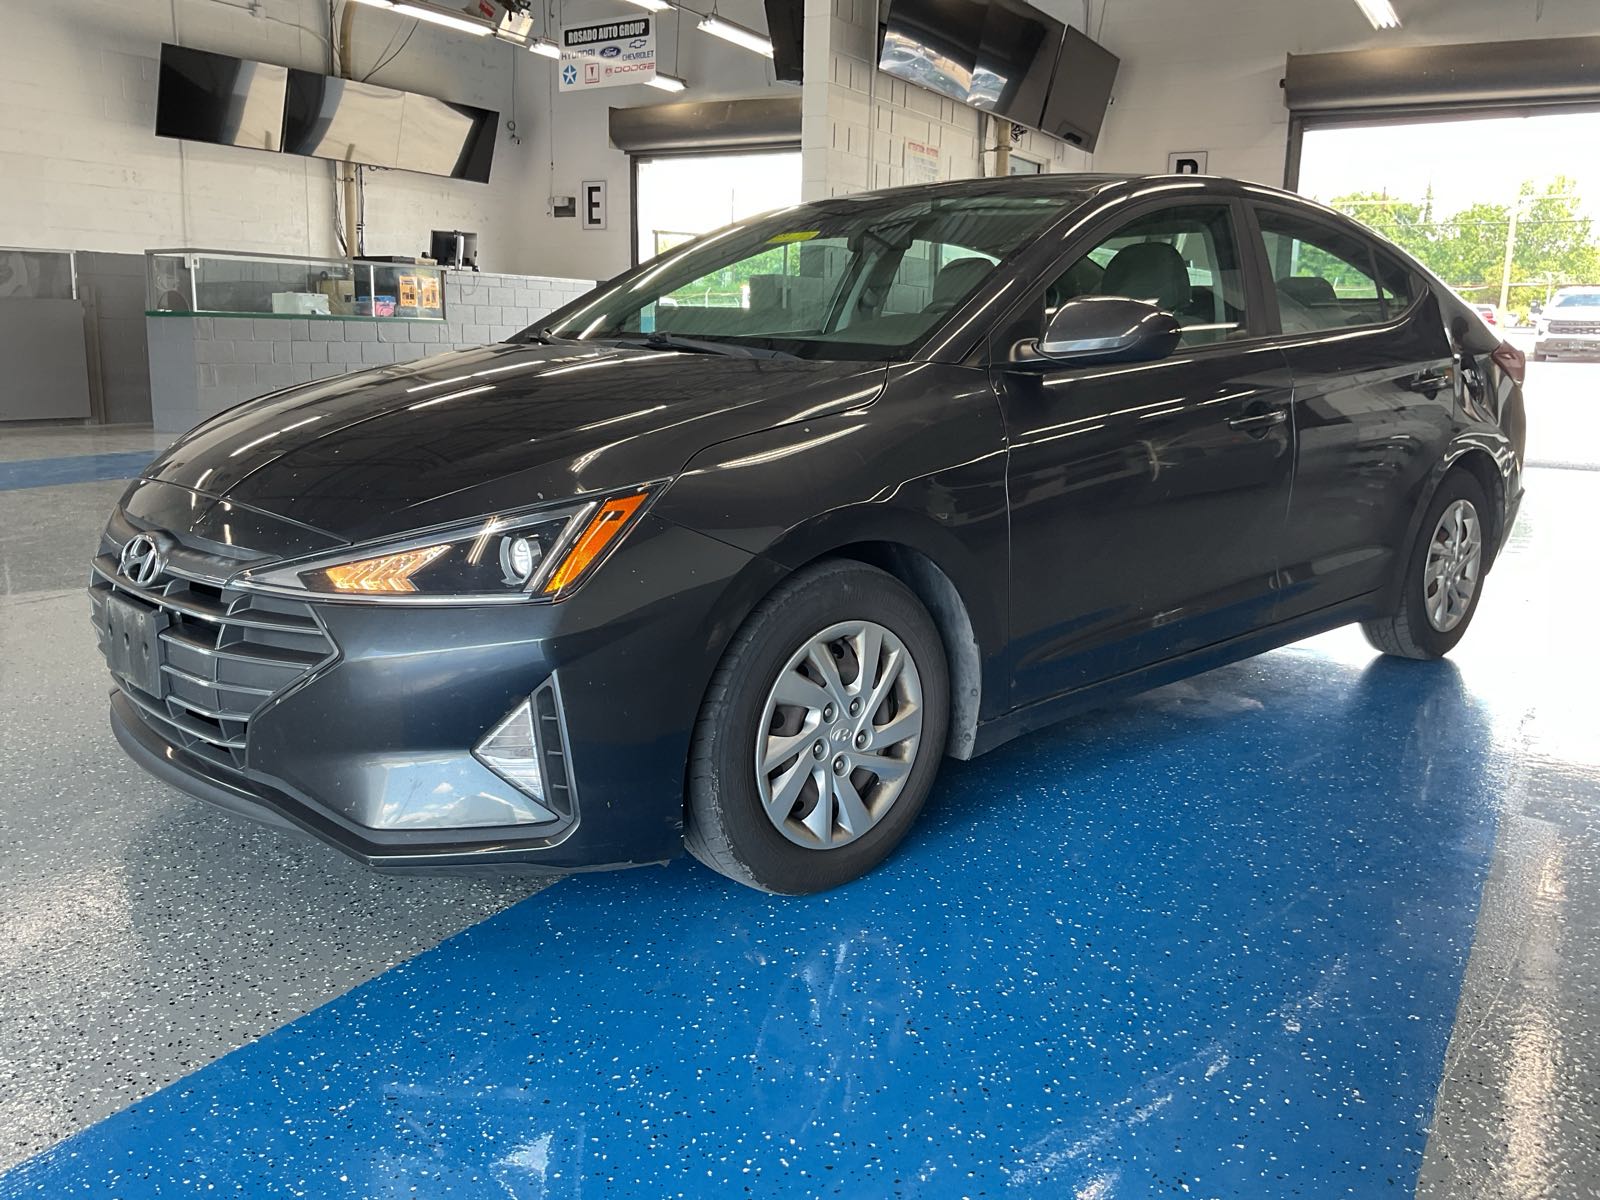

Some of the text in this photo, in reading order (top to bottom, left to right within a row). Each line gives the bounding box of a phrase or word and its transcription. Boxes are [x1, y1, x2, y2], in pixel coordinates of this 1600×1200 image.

[568, 21, 646, 44] ROSADO AUTO GROUP
[622, 50, 654, 61] CHEVROLET
[614, 62, 655, 73] DODGE
[588, 186, 601, 224] E
